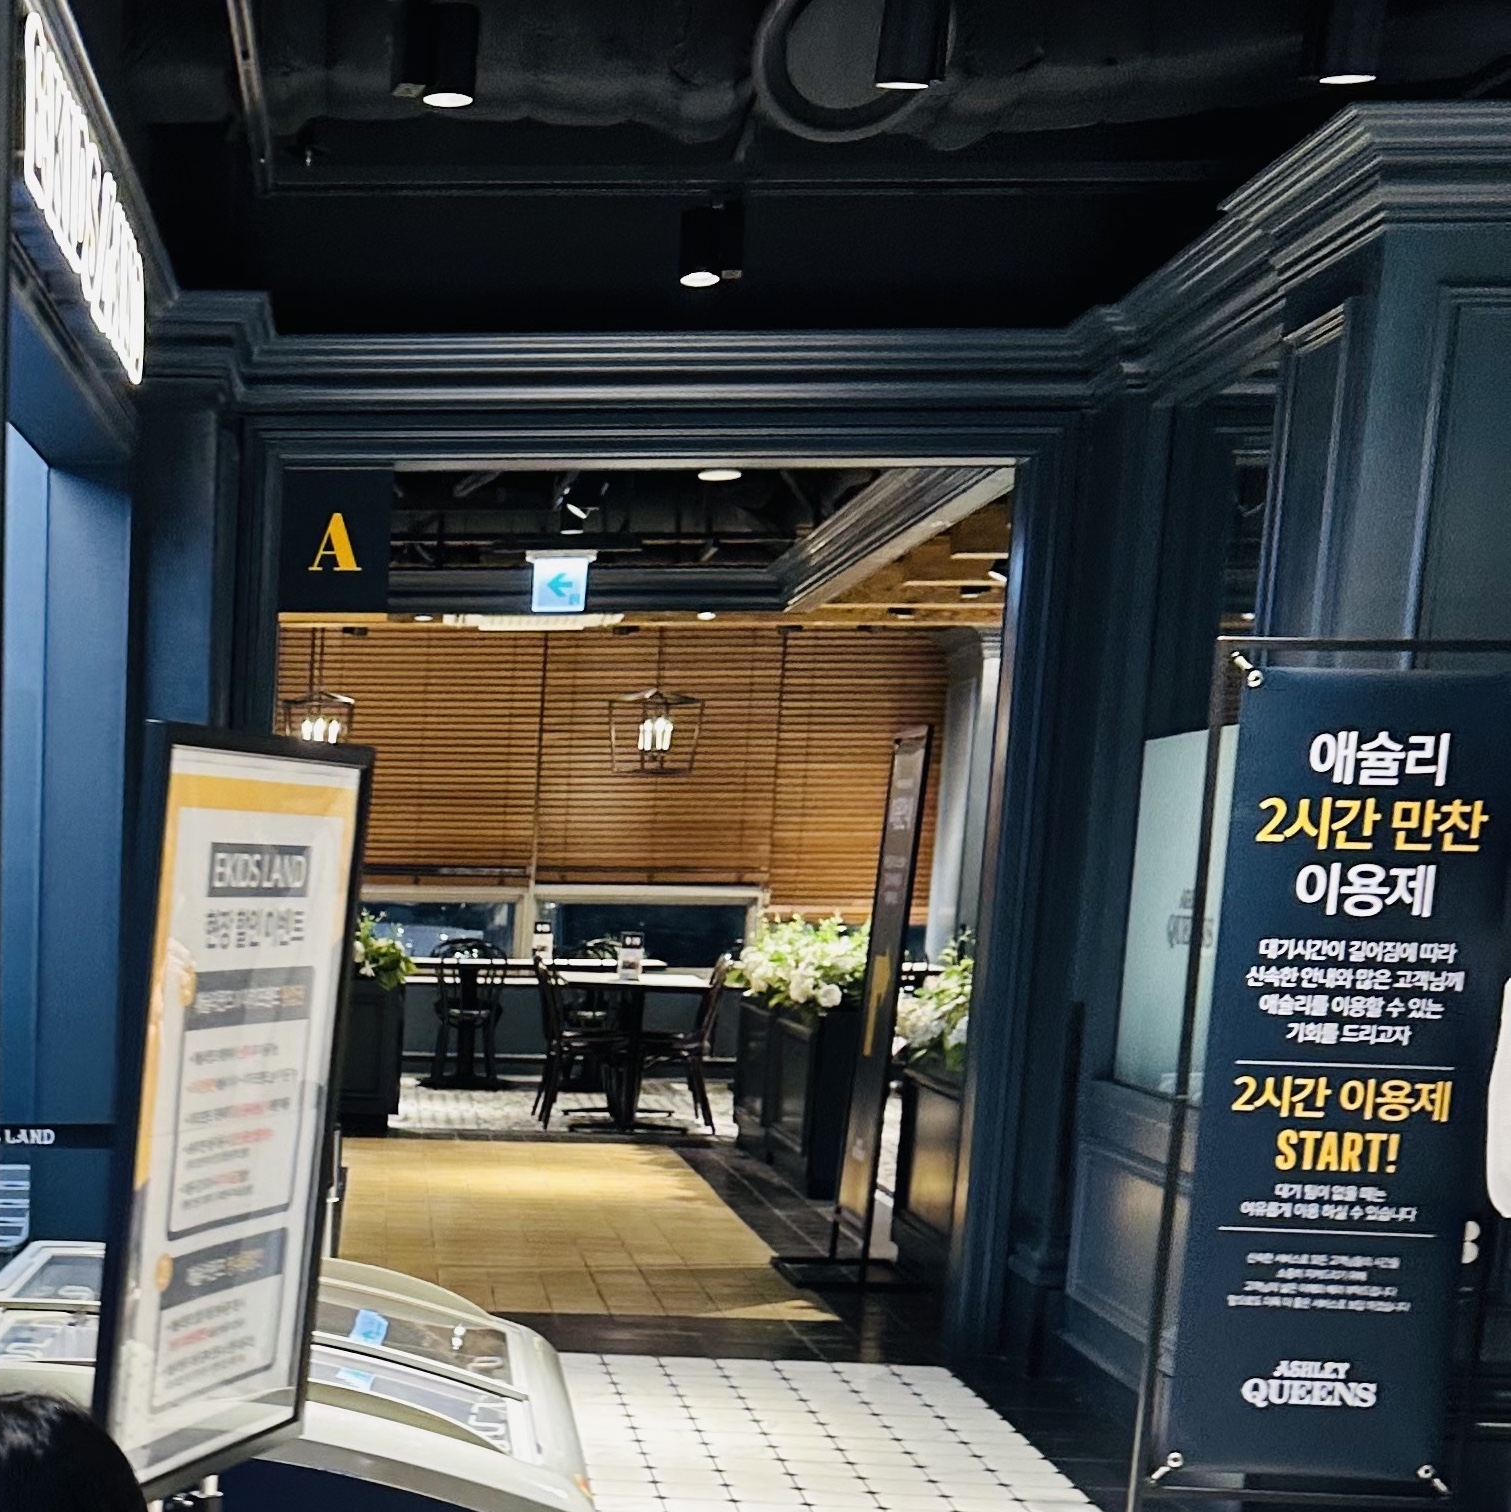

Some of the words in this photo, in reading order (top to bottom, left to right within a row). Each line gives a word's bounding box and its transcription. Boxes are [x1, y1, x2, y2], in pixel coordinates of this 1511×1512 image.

[308, 512, 363, 571] A
[1309, 731, 1451, 787] 애슐리
[1255, 797, 1382, 851] 2시간
[1391, 799, 1489, 852] 만찬
[1294, 862, 1437, 918] 이용제
[1258, 938, 1346, 961] 대기시간이
[1348, 940, 1418, 963] 길어짐에
[1419, 942, 1458, 964] 따라
[1246, 965, 1300, 988] 신속한
[1300, 967, 1355, 989] 안내와
[1355, 968, 1392, 990] 많은
[1393, 970, 1466, 992] 고객님께
[1258, 993, 1329, 1016] 애슐리를
[1331, 995, 1385, 1018] 이용할
[1386, 997, 1406, 1017] 수
[1407, 998, 1445, 1019] 있는
[1285, 1022, 1340, 1044] 기회를
[1340, 1024, 1413, 1046] 드리고자
[1230, 1074, 1332, 1119] 2시간
[1339, 1079, 1452, 1123] 이용제
[4, 1129, 56, 1145] LAND
[1274, 1129, 1401, 1173] START!
[1273, 1360, 1350, 1379] ASHLEY
[1240, 1378, 1377, 1408] QUEENS
